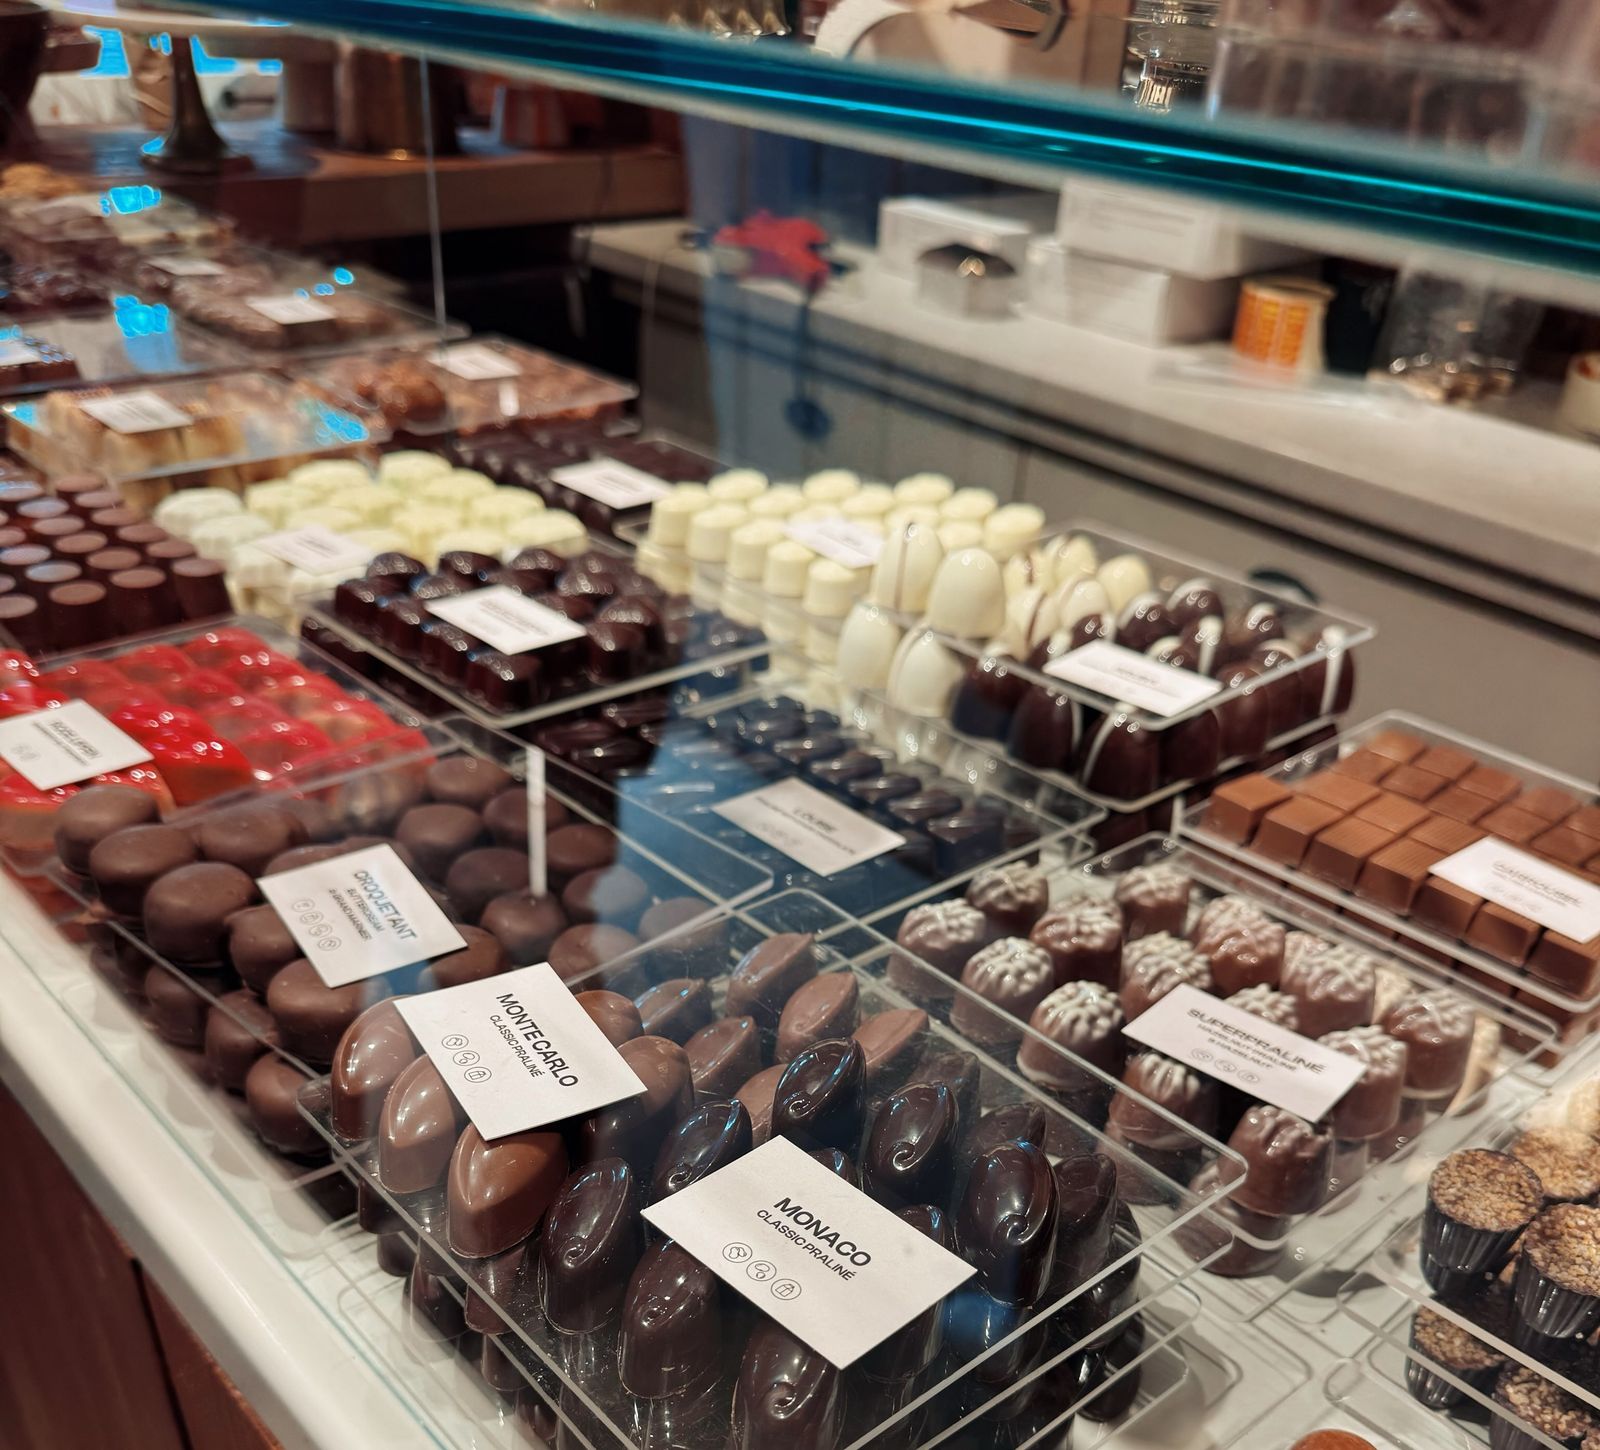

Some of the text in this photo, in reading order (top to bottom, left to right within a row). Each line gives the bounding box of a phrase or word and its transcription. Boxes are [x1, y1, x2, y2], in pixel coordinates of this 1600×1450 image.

[354, 870, 417, 940] CROQUETANT
[489, 1014, 545, 1078] CLASSIC PRALINÉ
[496, 993, 579, 1087] MONTE CARLO
[756, 1209, 857, 1281] CLASSIC PRALINÉ
[773, 1196, 872, 1267] MONACO
